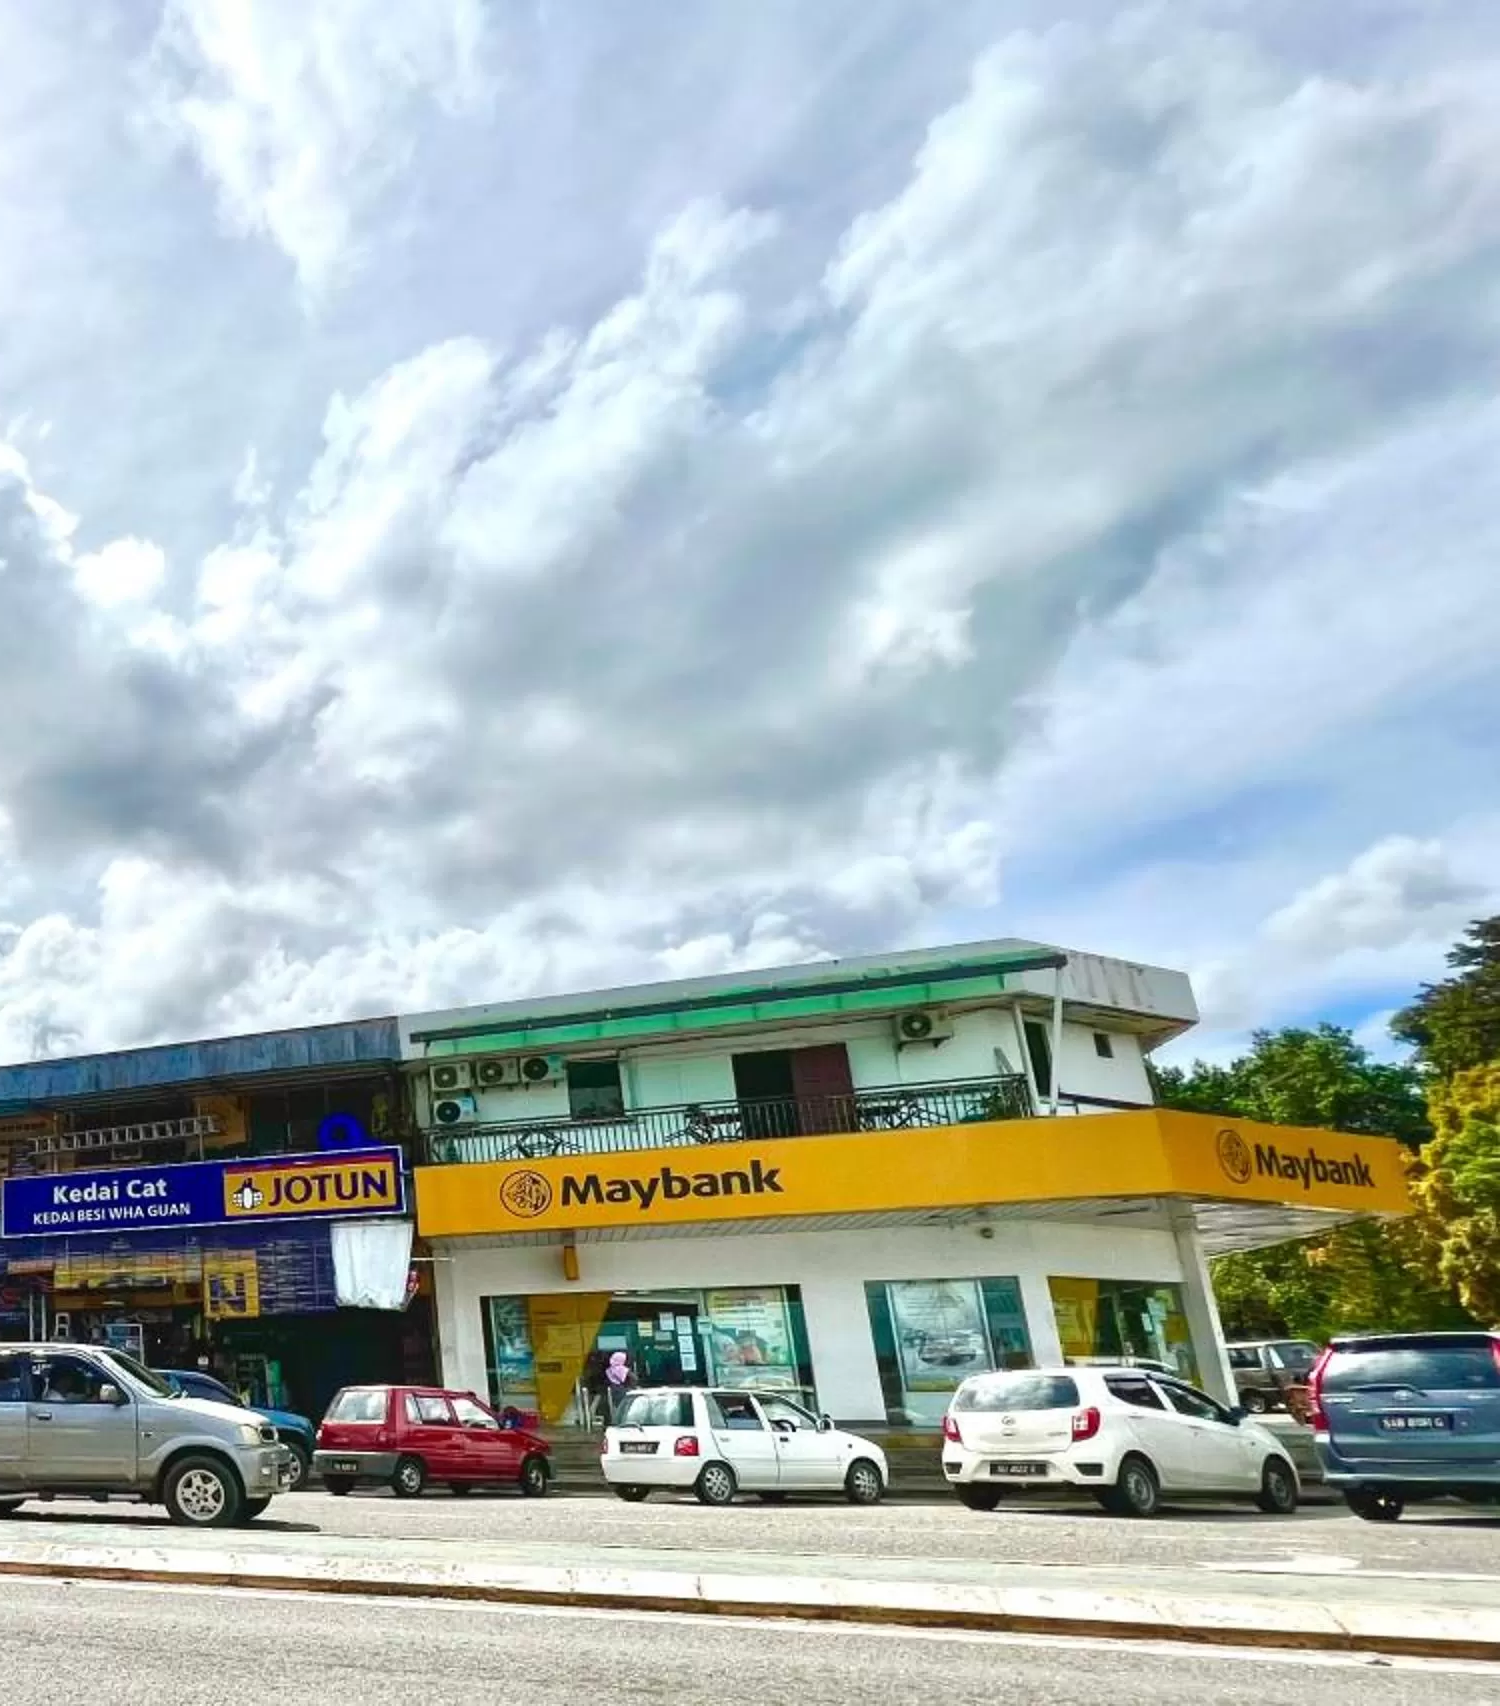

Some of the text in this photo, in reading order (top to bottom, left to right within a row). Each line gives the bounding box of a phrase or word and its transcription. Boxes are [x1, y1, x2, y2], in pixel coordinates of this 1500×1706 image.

[561, 1159, 784, 1210] Maybank
[1254, 1143, 1377, 1191] Maybank
[52, 1178, 168, 1205] Kedai Cat
[268, 1169, 388, 1207] JOTUN
[32, 1202, 191, 1225] KEDAI BESI WHA GUAN
